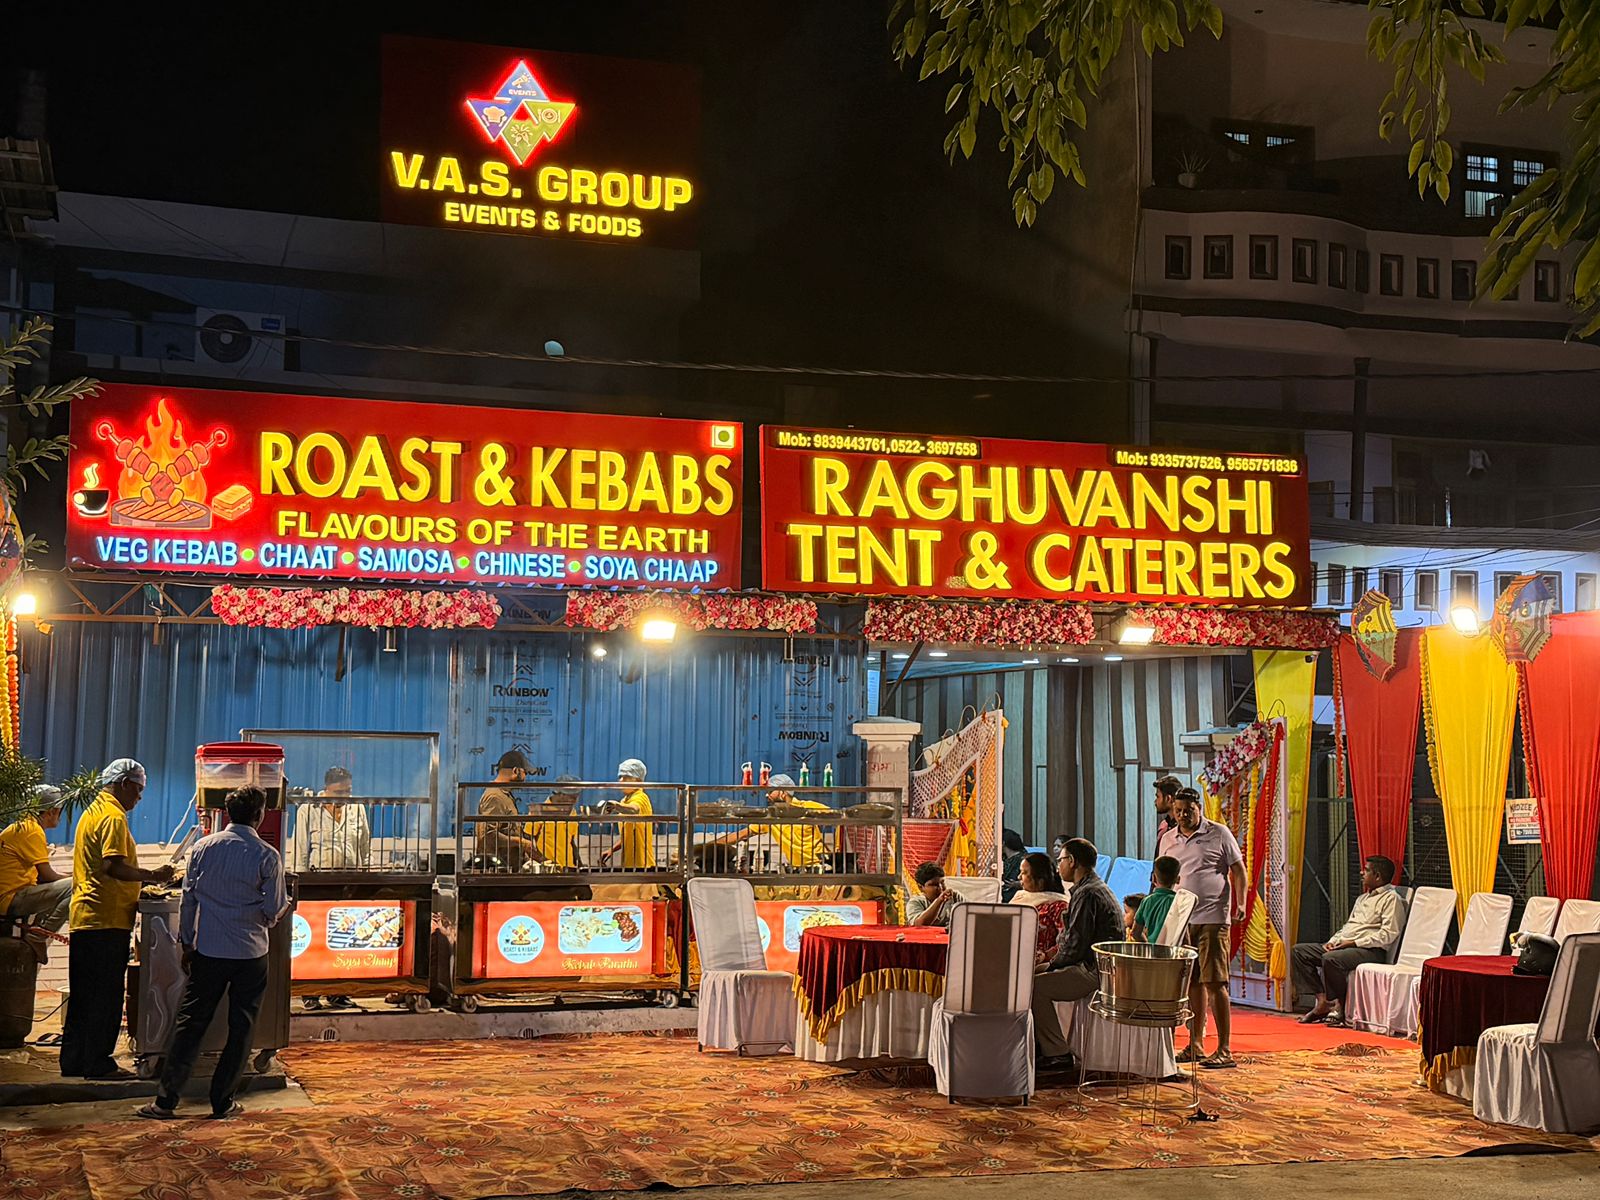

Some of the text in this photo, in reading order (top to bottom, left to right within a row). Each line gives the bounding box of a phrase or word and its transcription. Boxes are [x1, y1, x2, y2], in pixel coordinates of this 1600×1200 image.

[391, 151, 692, 211] V.A.S. GROUP
[445, 202, 642, 237] EVENTS & FOODS
[779, 432, 811, 447] Mob:
[260, 431, 734, 516] ROAST & KEBABS
[1116, 451, 1148, 465] Mob:
[1227, 458, 1298, 473] 9565751836
[813, 457, 1273, 535] RAGHUVANSHI
[278, 510, 709, 553] FLAVOURS OF THE EARTH
[96, 536, 238, 566] VEG KEBAB
[260, 543, 337, 569] CHAAT
[358, 546, 454, 574] SAMOSA
[475, 551, 566, 578] CHINESE
[788, 523, 1295, 599] TENT & CATERERS
[585, 555, 719, 583] SOYA CHAAP
